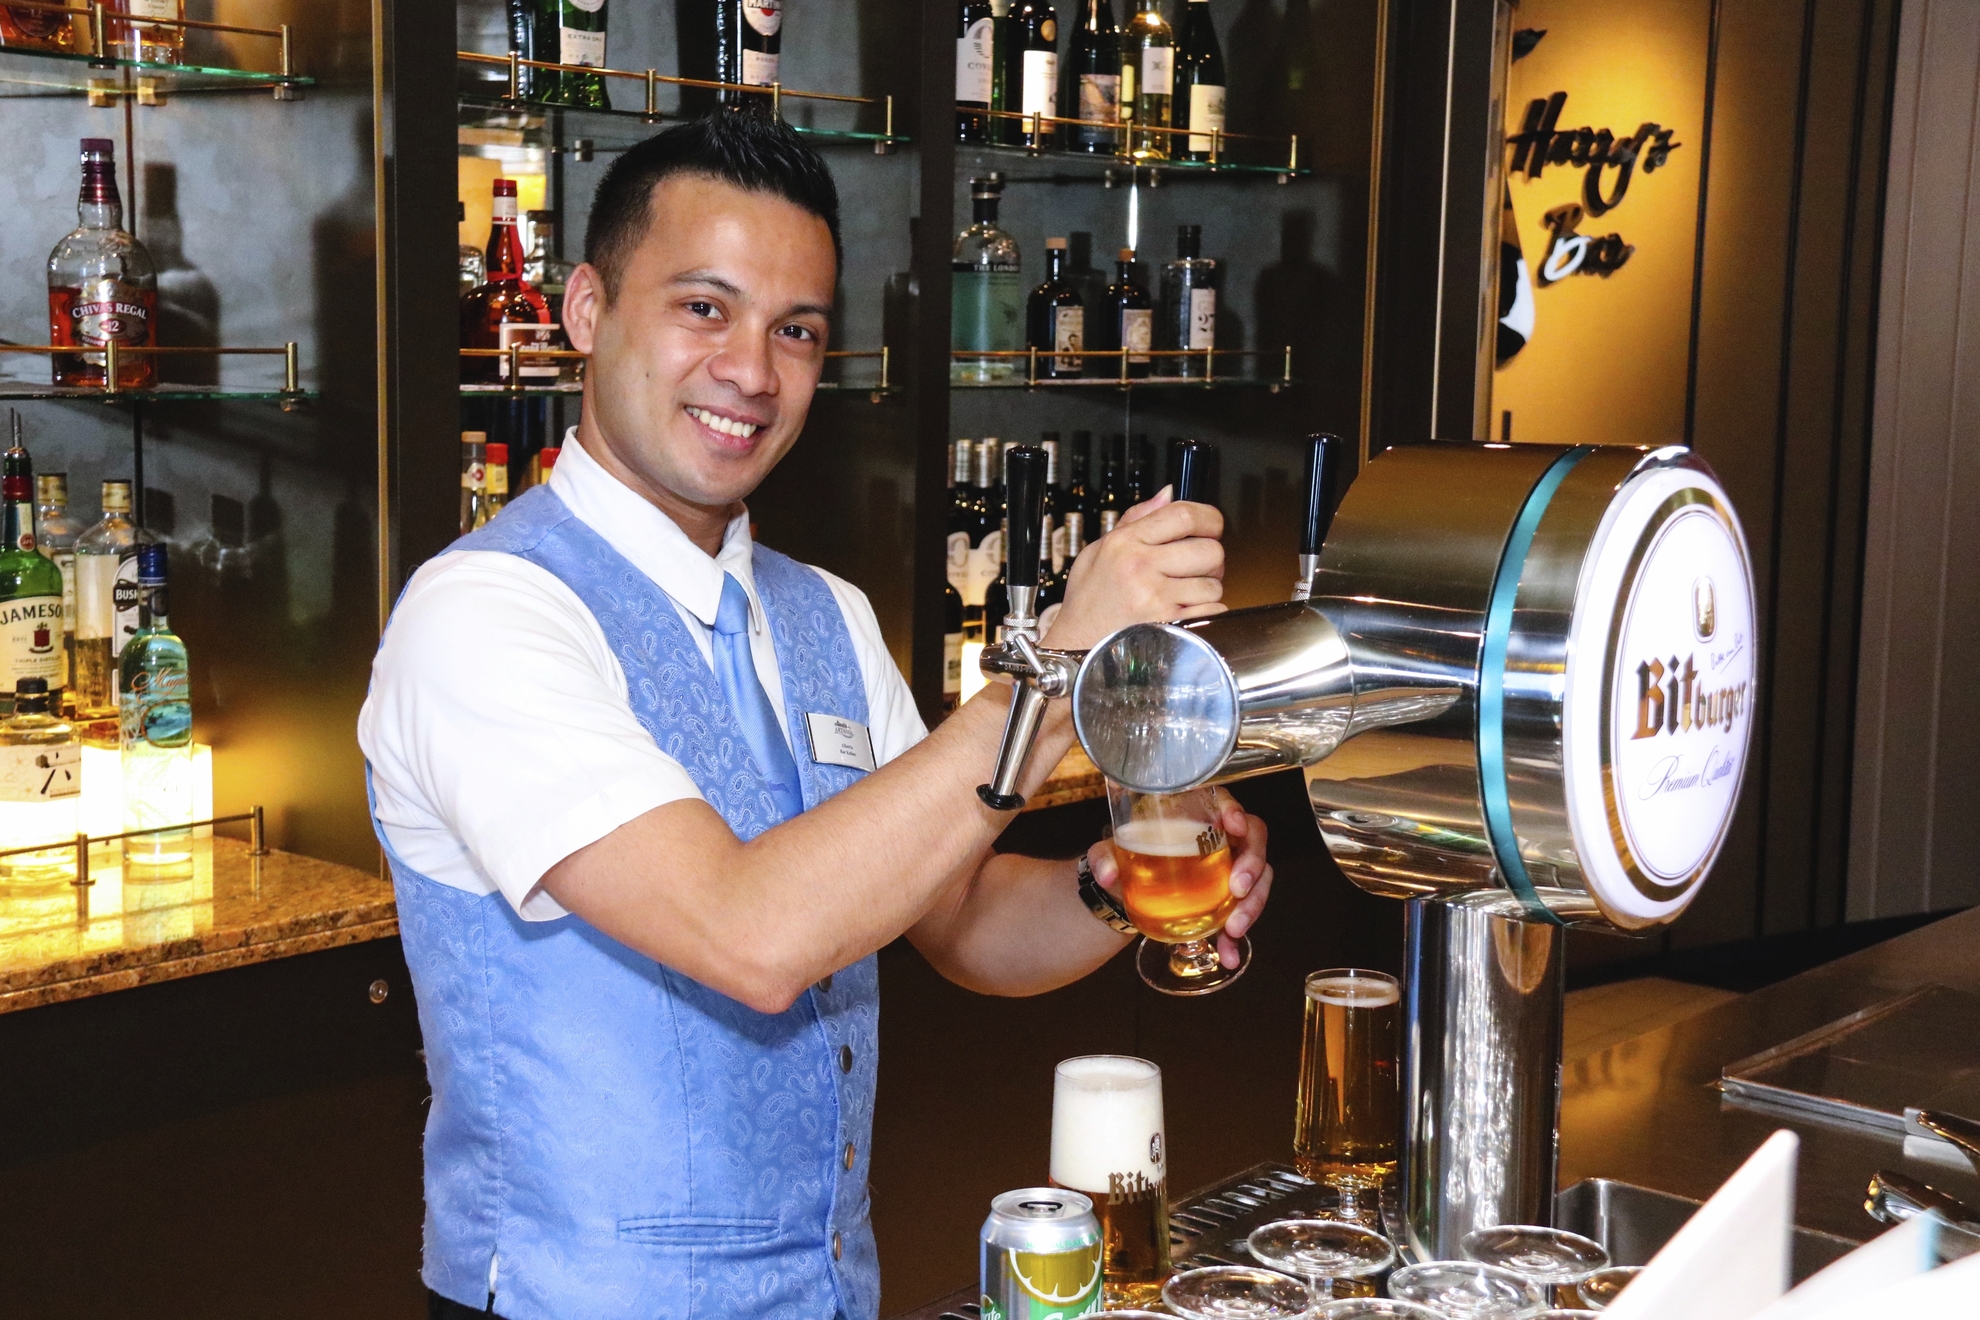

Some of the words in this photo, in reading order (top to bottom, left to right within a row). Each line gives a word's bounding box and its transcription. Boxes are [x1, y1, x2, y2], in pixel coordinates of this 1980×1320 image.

[115, 302, 147, 320] REGAL
[107, 320, 120, 332] 12
[0, 603, 64, 625] JAMESO
[1629, 651, 1747, 741] Bitburger
[1638, 754, 1701, 801] Premium
